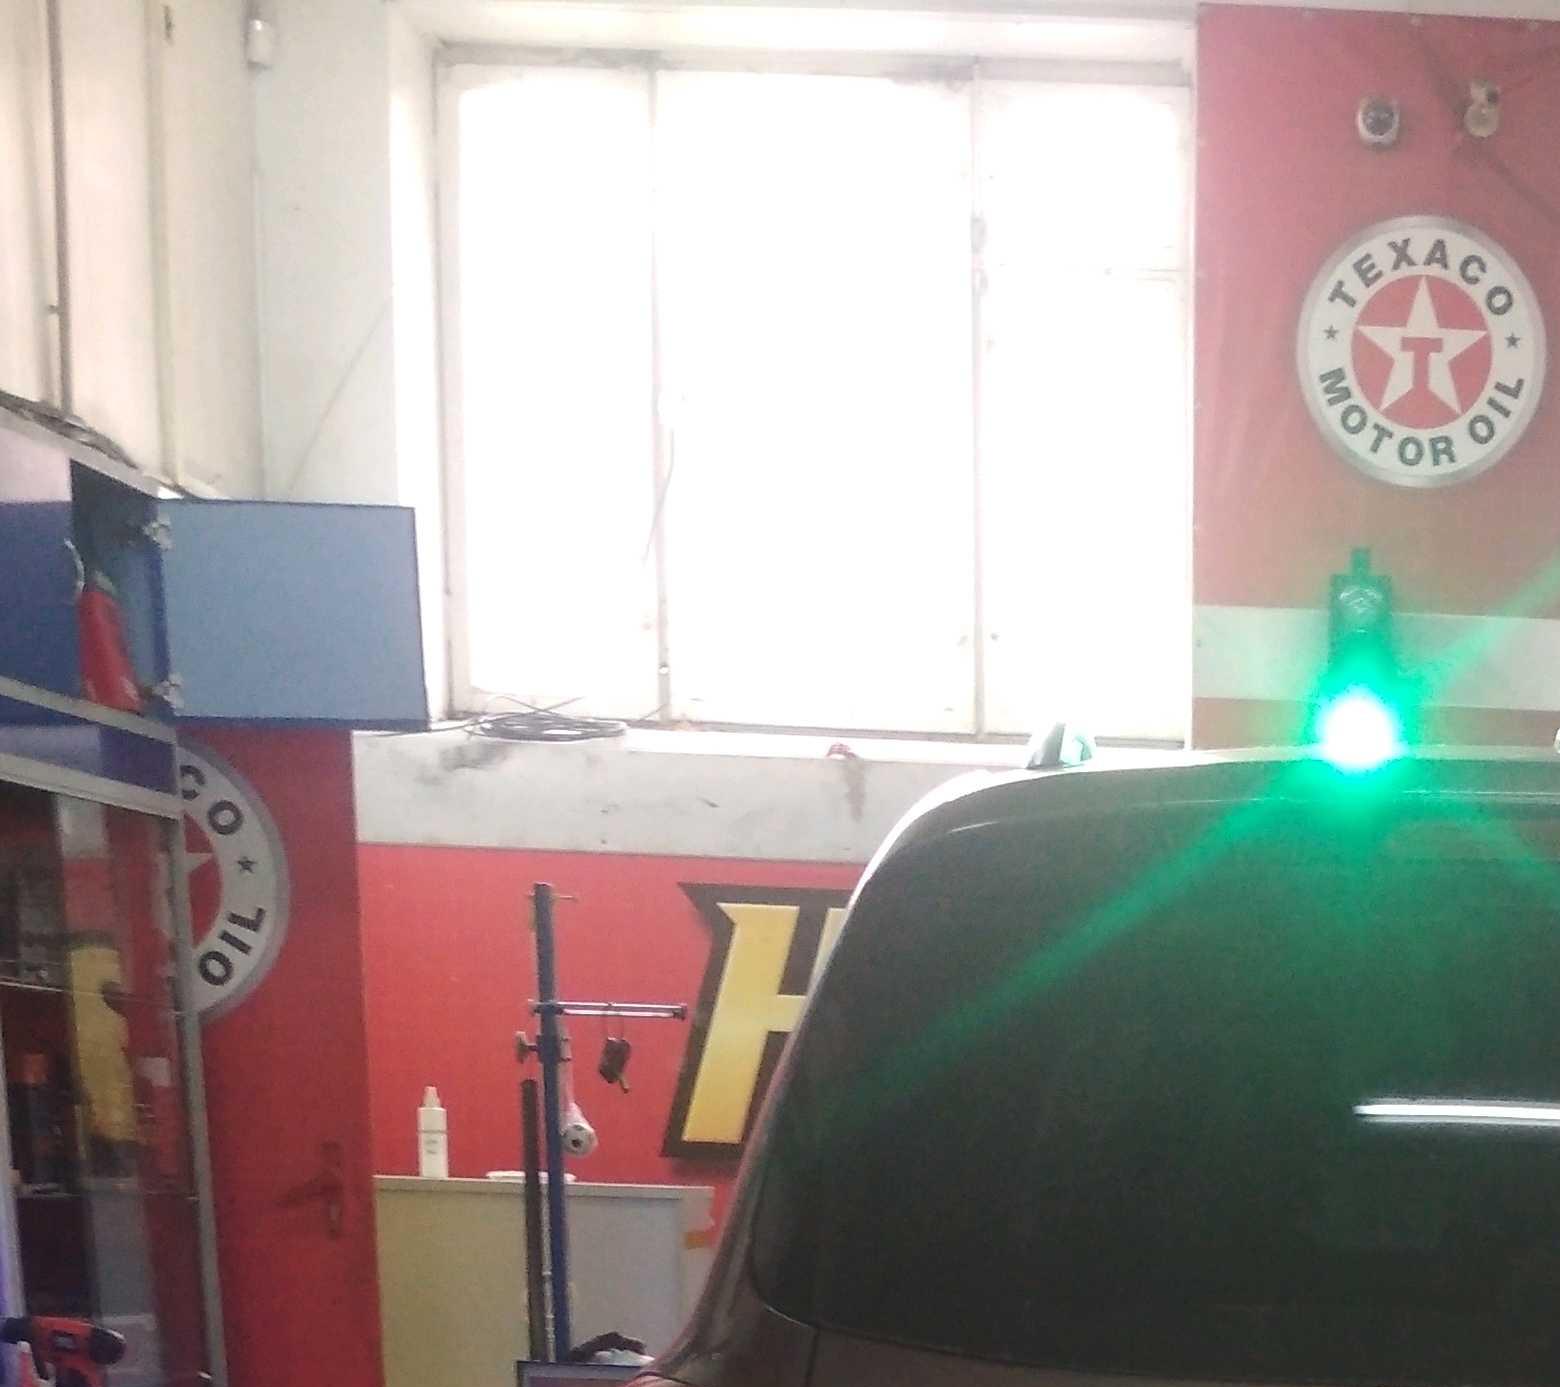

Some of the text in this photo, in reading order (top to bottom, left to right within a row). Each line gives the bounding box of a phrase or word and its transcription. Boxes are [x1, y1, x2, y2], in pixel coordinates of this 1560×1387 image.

[1328, 239, 1514, 317] TEXACO
[1319, 367, 1525, 466] MOTOR OIL
[199, 907, 267, 986] OIL
